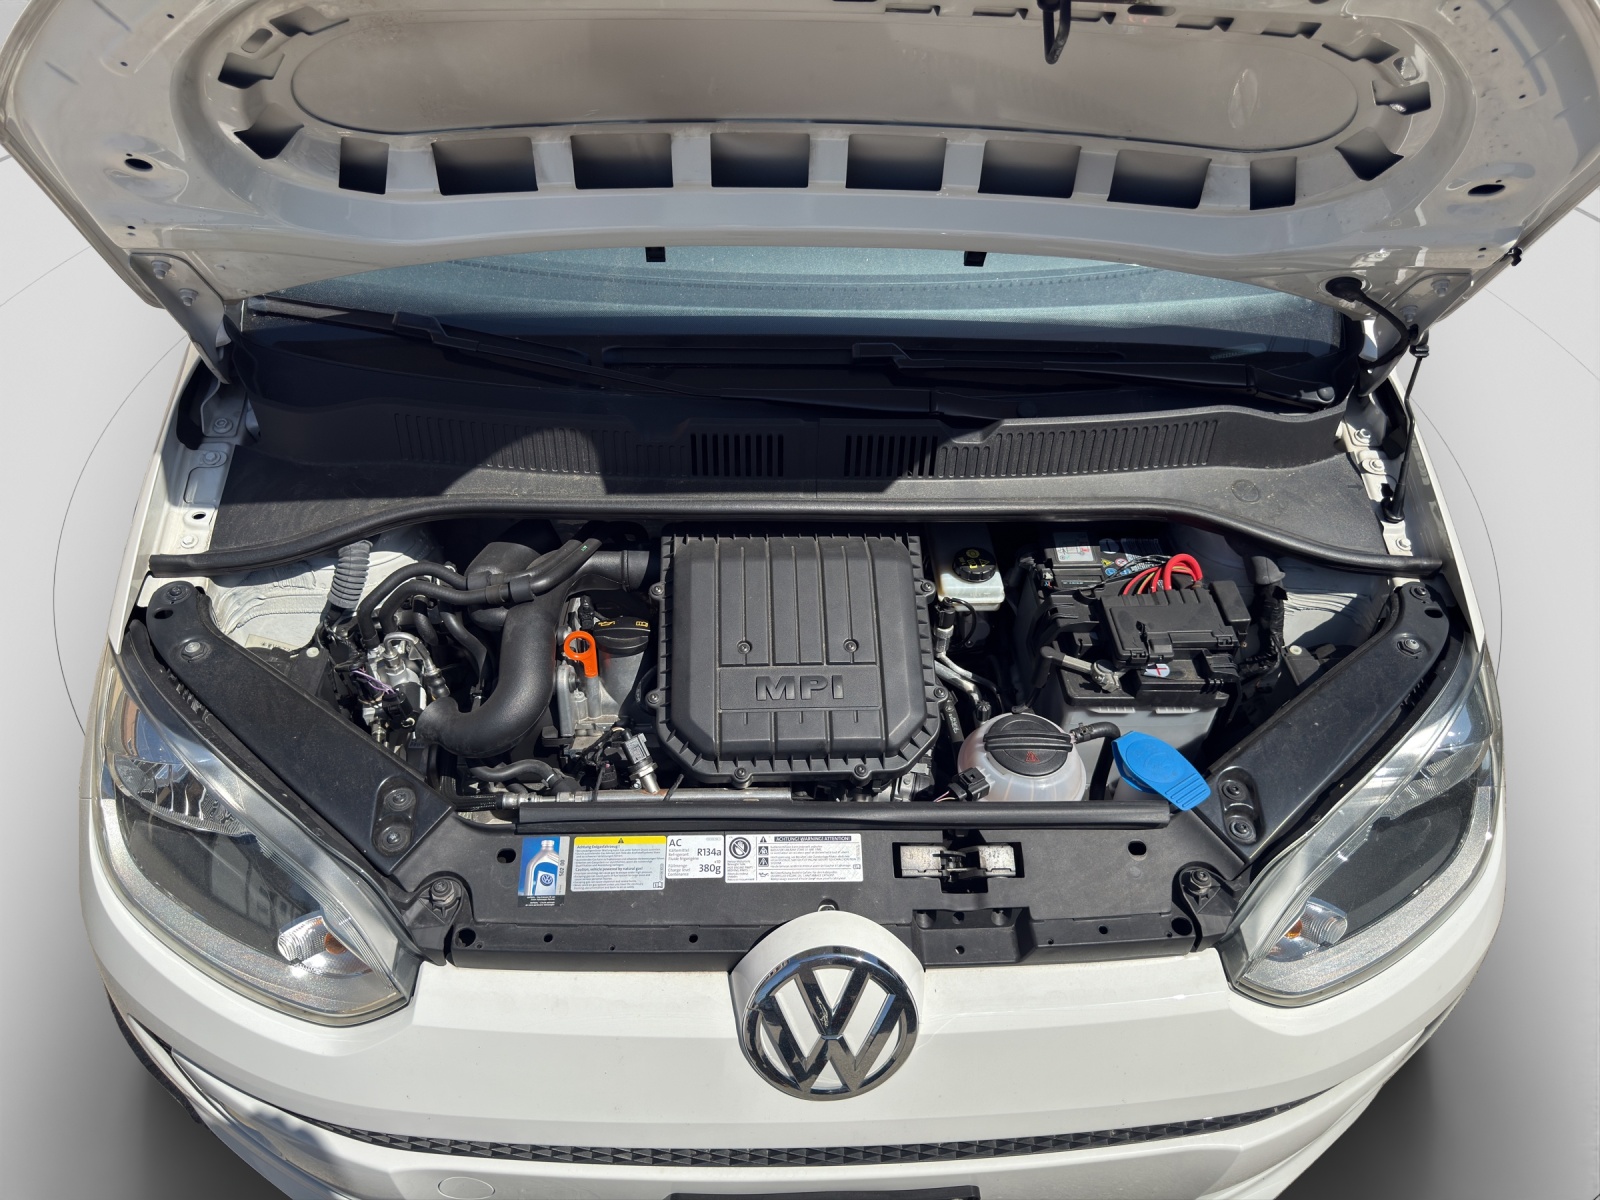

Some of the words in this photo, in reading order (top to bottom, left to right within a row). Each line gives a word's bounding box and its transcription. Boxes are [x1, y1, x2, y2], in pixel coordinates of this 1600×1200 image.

[756, 674, 844, 701] MPI
[669, 838, 682, 847] AC
[697, 848, 722, 856] R134a
[699, 864, 721, 874] 380g
[540, 874, 554, 886] VW
[742, 945, 919, 1102] VW
